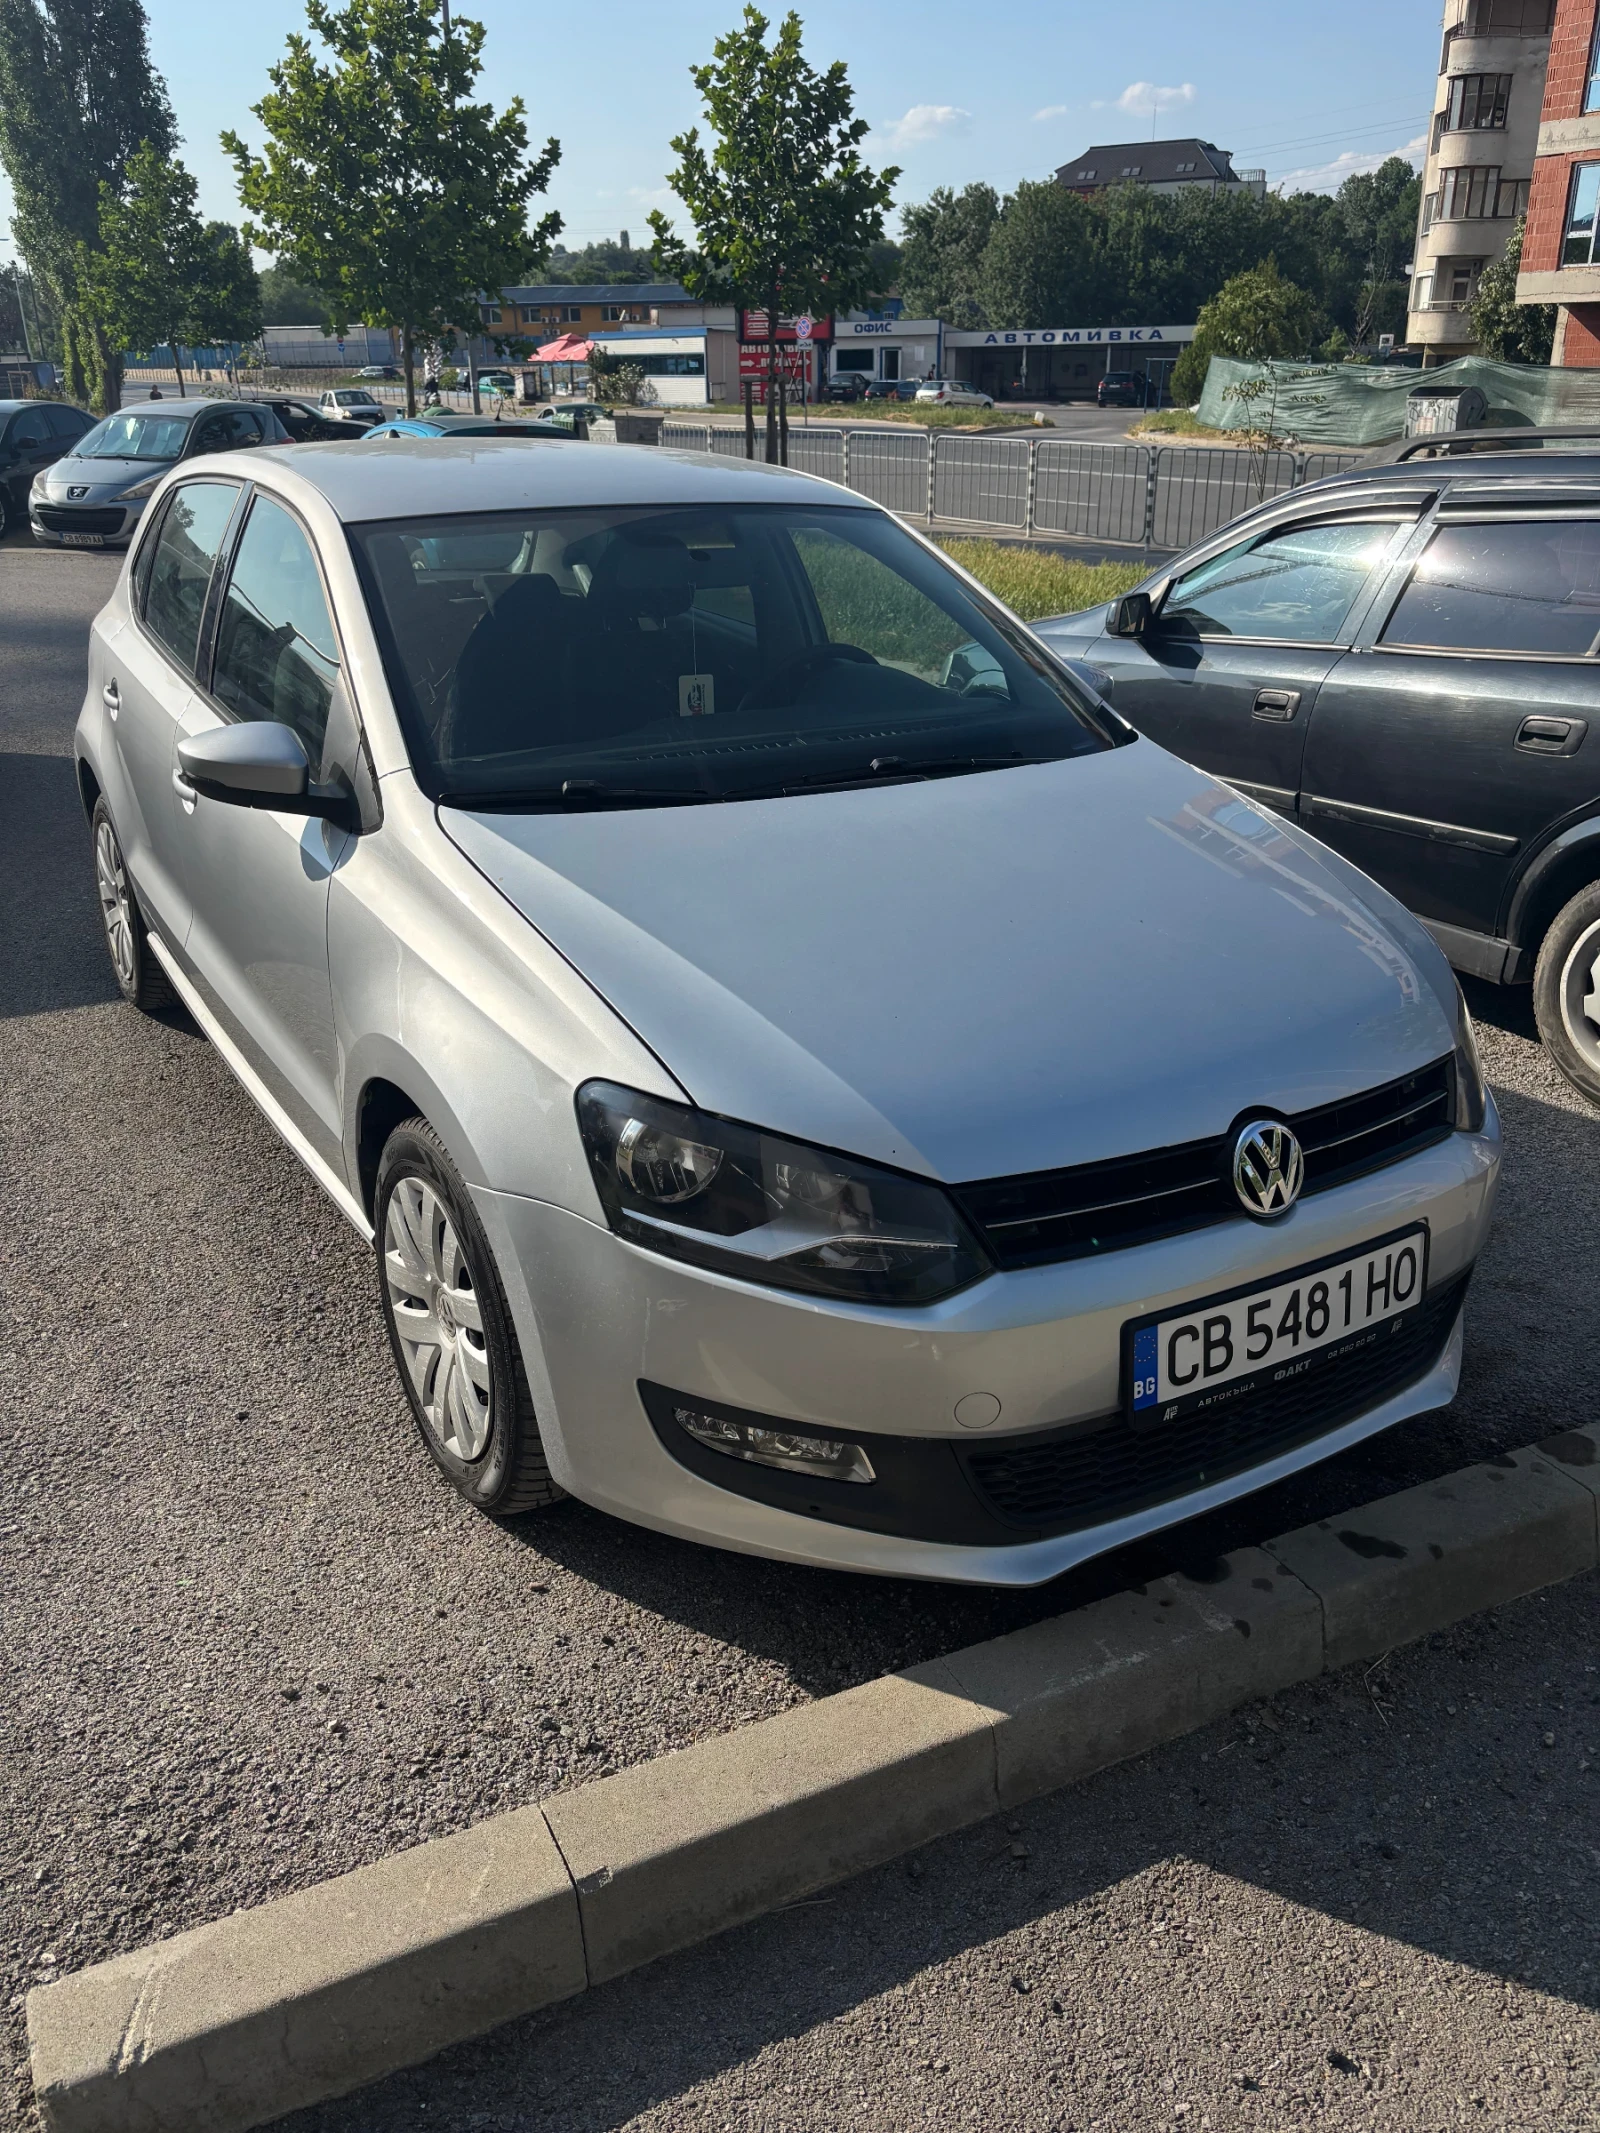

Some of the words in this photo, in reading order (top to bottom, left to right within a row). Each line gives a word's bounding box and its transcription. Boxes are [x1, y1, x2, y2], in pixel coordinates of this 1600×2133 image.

[854, 322, 892, 334] ОФИС
[984, 329, 1163, 344] АВТОМИВКА
[1246, 1269, 1353, 1361] 5481
[1274, 1359, 1311, 1381] ФАКТ
[1133, 1376, 1156, 1399] BG
